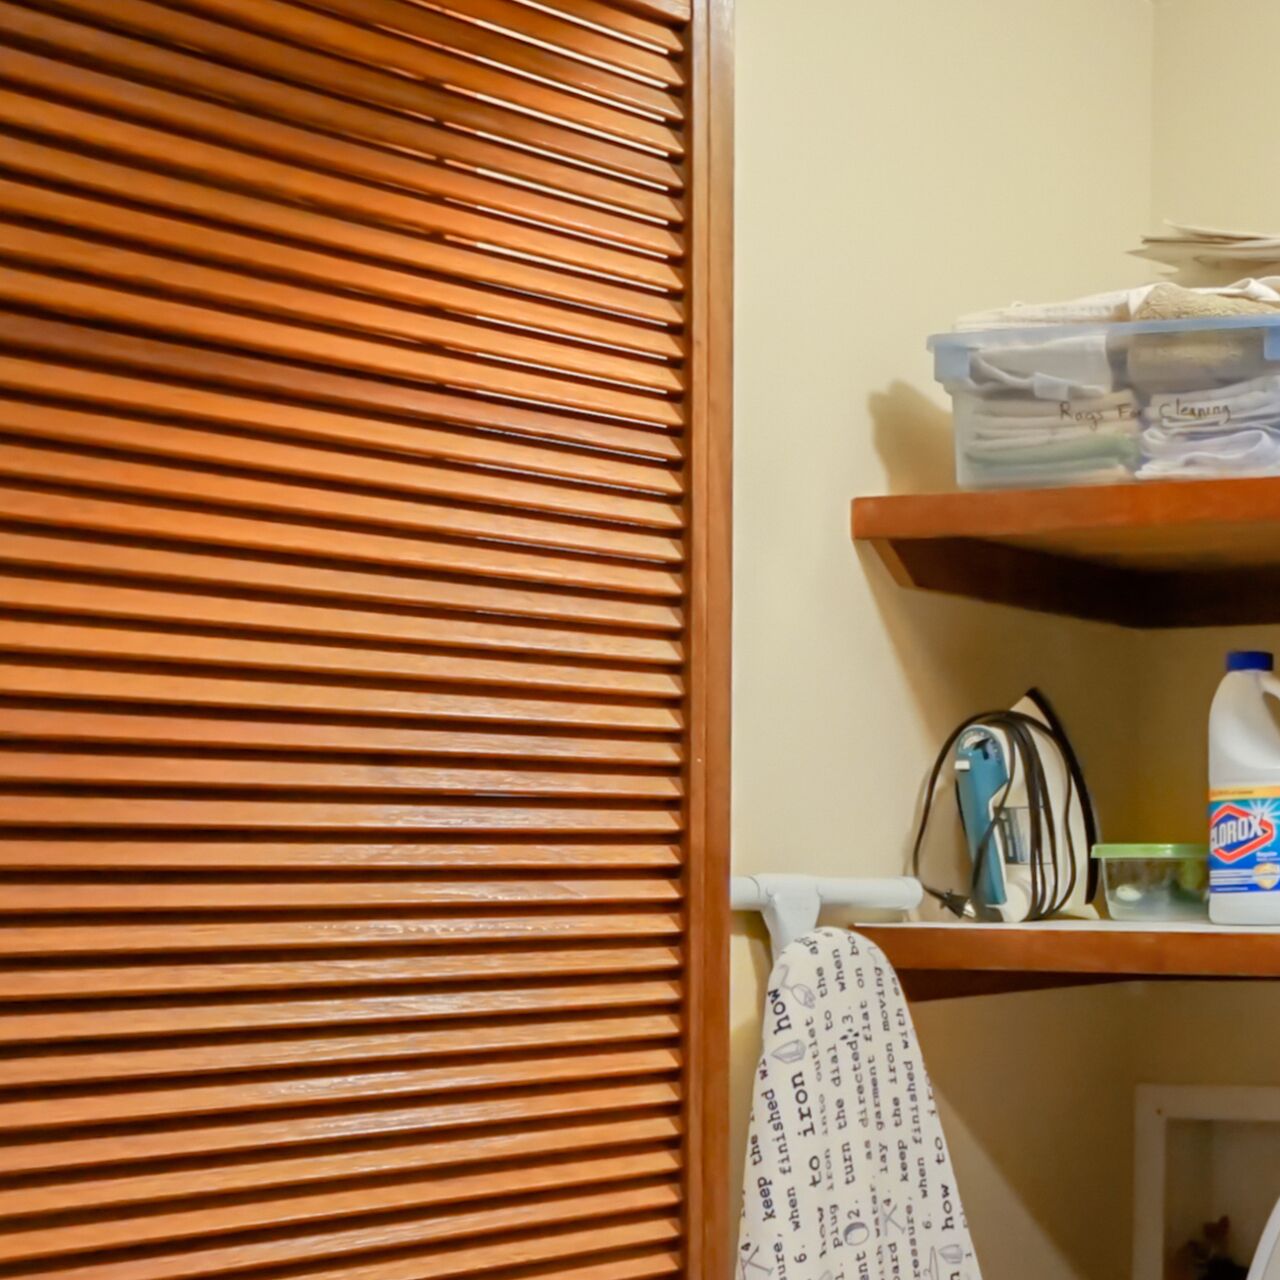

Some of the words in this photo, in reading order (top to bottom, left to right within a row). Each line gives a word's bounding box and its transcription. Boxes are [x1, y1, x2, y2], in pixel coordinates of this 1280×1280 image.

[1060, 401, 1104, 431] Rags
[1159, 398, 1232, 424] Cleaning
[814, 966, 828, 998] the
[831, 948, 847, 992] when
[854, 967, 865, 988] on
[768, 988, 792, 1035] how
[822, 1010, 833, 1031] to
[859, 1000, 873, 1042] flat
[873, 966, 890, 1032] moving
[805, 1016, 822, 1082] outlet
[896, 1007, 909, 1050] with
[827, 1043, 841, 1087] dial
[844, 1040, 869, 1128] directed
[885, 1041, 898, 1085] iron
[791, 1071, 815, 1137] iron
[836, 1098, 847, 1130] the
[867, 1055, 885, 1130] garment
[892, 1096, 903, 1127] the
[904, 1060, 922, 1144] finished
[746, 1134, 763, 1166] the
[761, 1088, 792, 1175] finished
[864, 1140, 873, 1160] as
[933, 1136, 945, 1165] to
[808, 1155, 822, 1188] to
[841, 1141, 856, 1185] turn
[879, 1141, 888, 1174] lay
[898, 1139, 910, 1182] keep
[915, 1157, 929, 1199] when
[757, 1177, 777, 1221] keep
[786, 1187, 803, 1231] when
[940, 1183, 954, 1231] how
[828, 1204, 843, 1248] plug
